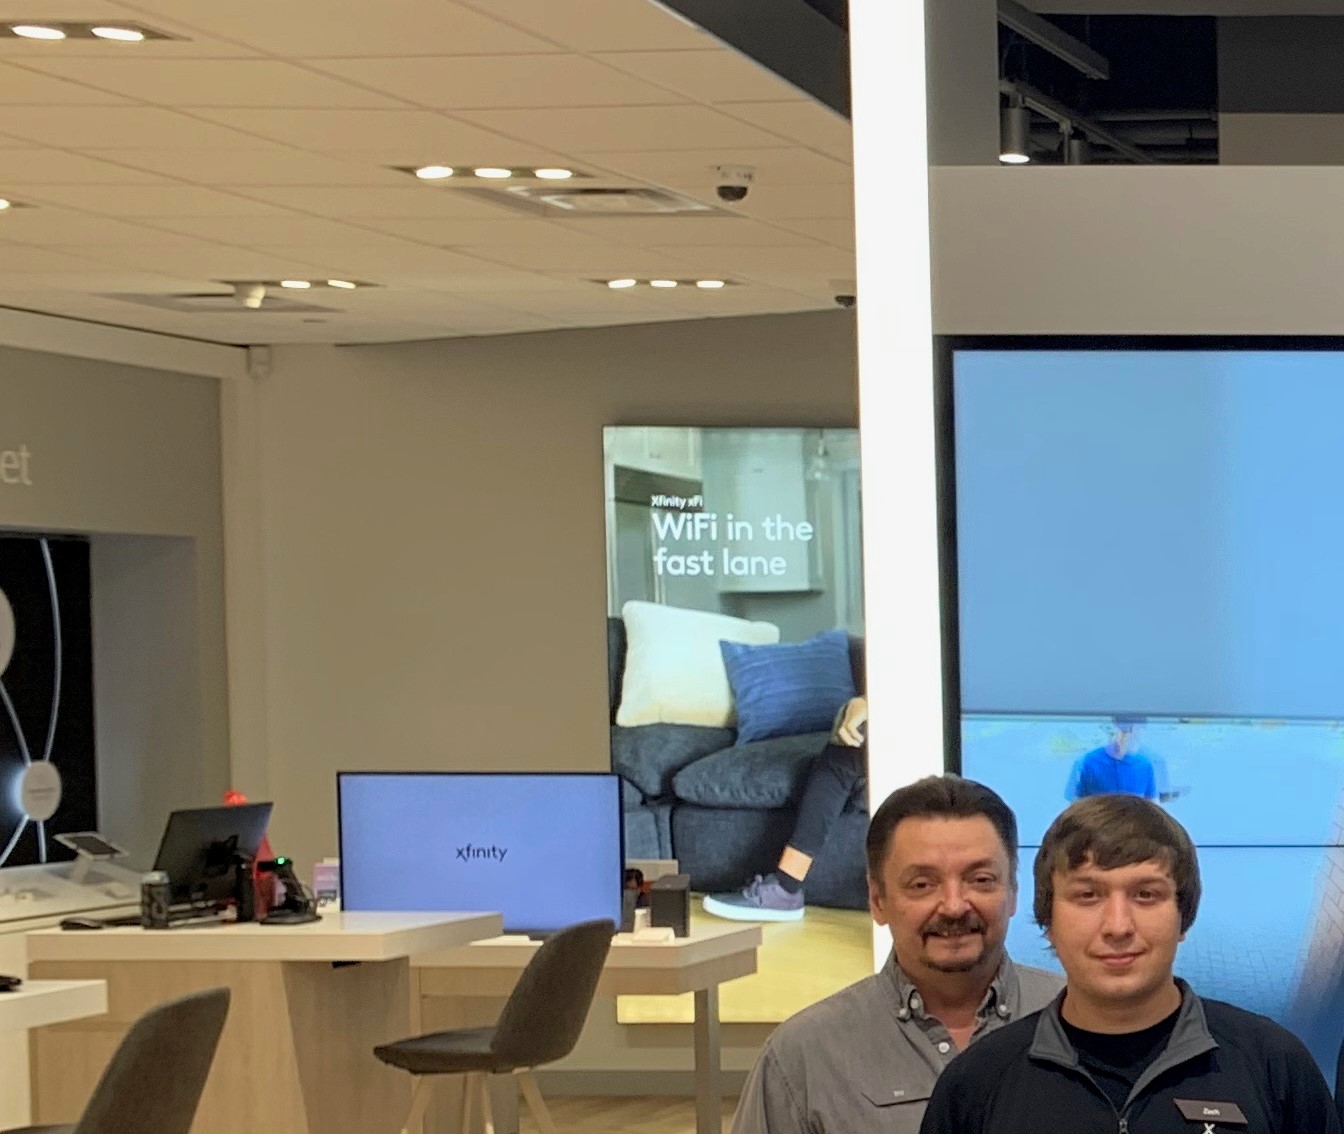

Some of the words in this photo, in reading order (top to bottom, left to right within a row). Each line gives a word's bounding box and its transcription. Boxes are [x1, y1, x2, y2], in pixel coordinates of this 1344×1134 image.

[651, 494, 686, 510] Xfinity
[652, 512, 717, 541] WiFi
[726, 513, 753, 541] in
[762, 513, 814, 542] the
[653, 546, 715, 576] fast
[723, 547, 787, 576] lane
[456, 843, 508, 863] xfinity
